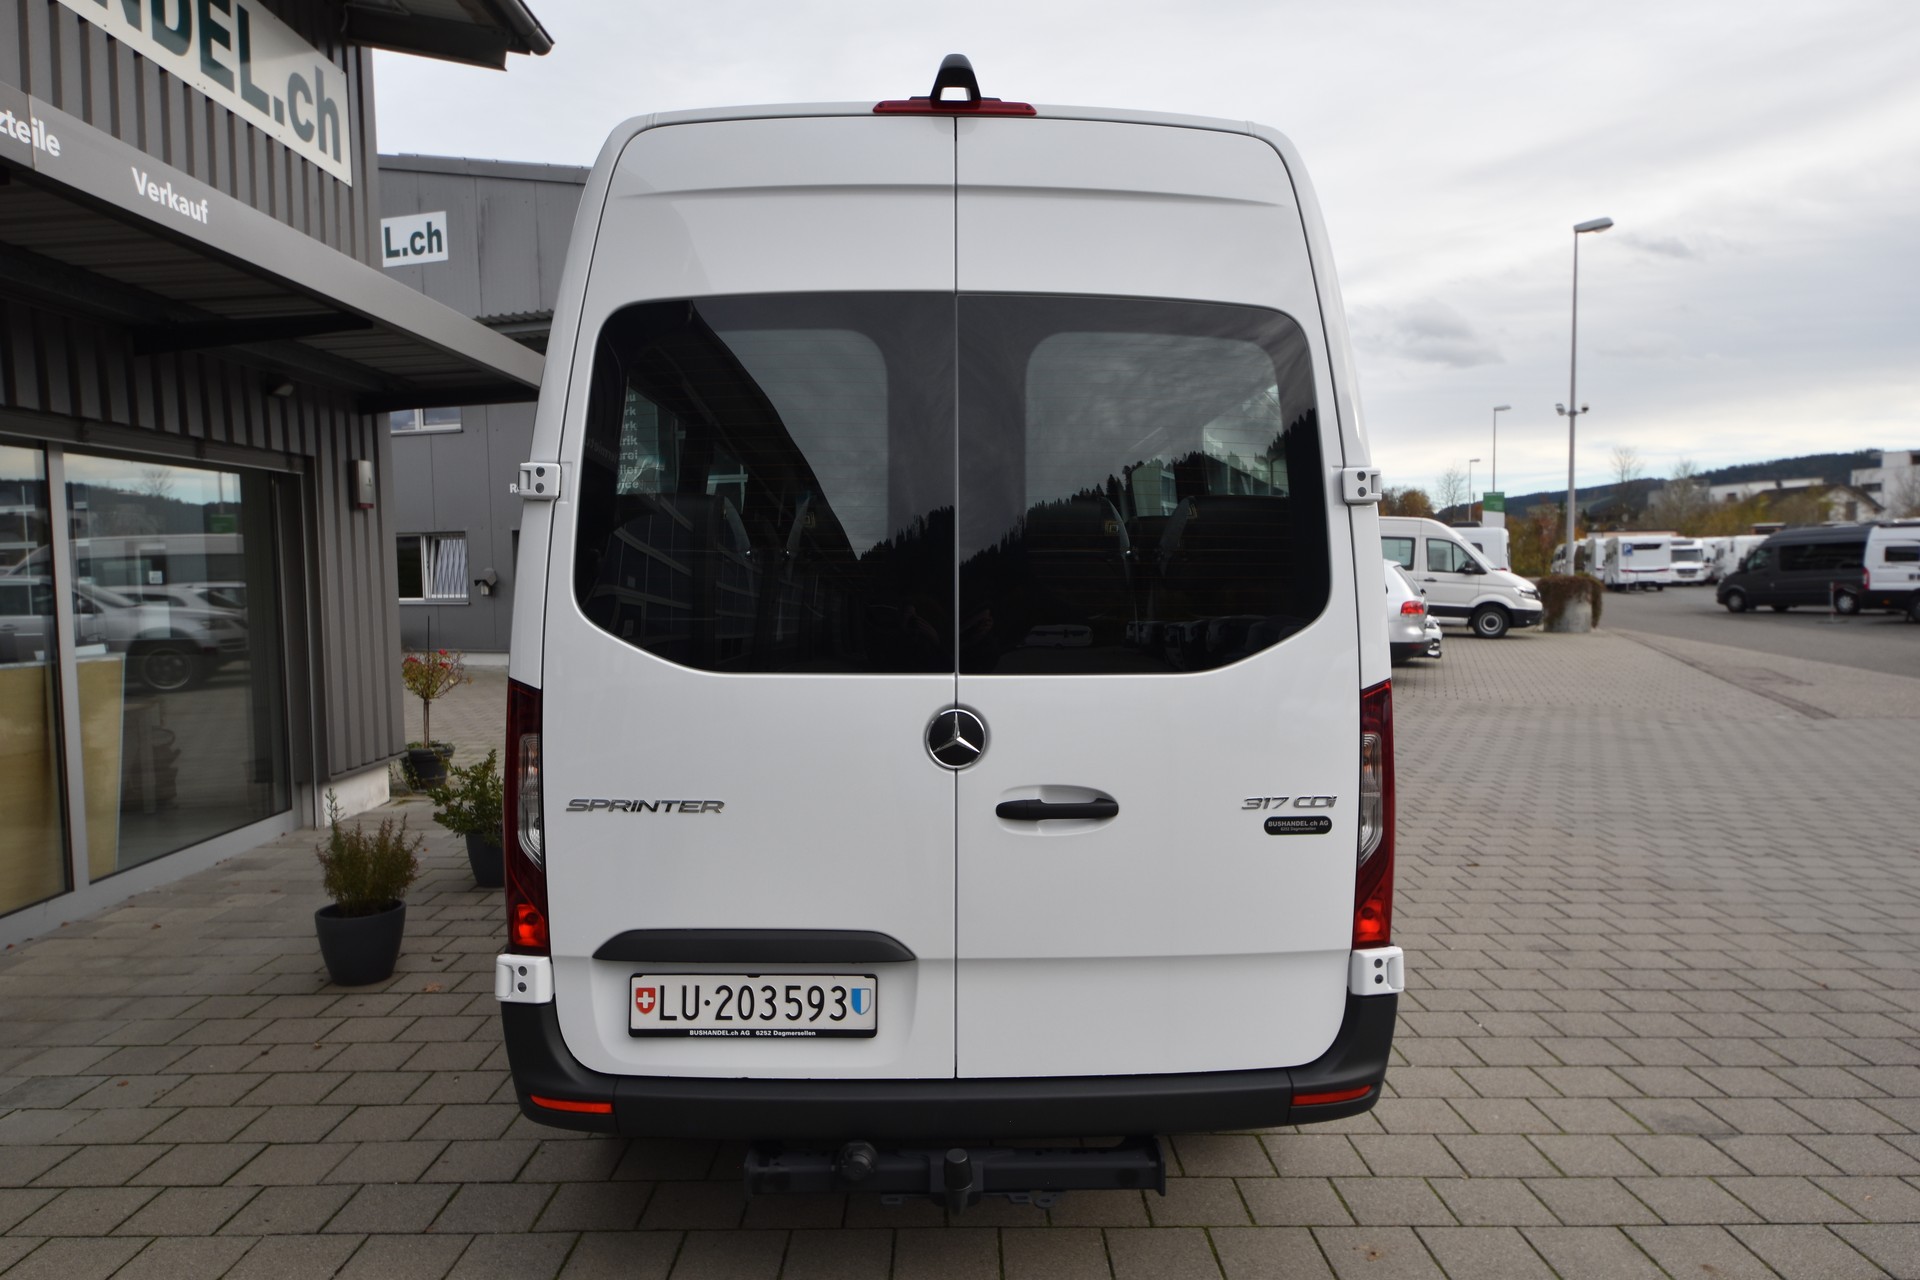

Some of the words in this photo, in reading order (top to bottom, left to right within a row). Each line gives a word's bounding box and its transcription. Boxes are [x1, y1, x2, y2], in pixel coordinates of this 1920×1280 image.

[131, 166, 208, 224] Verkauf
[384, 221, 443, 258] L.ch
[566, 798, 725, 813] SPRINTER
[1241, 796, 1289, 810] 317
[773, 1029, 816, 1037] Dagmersellen
